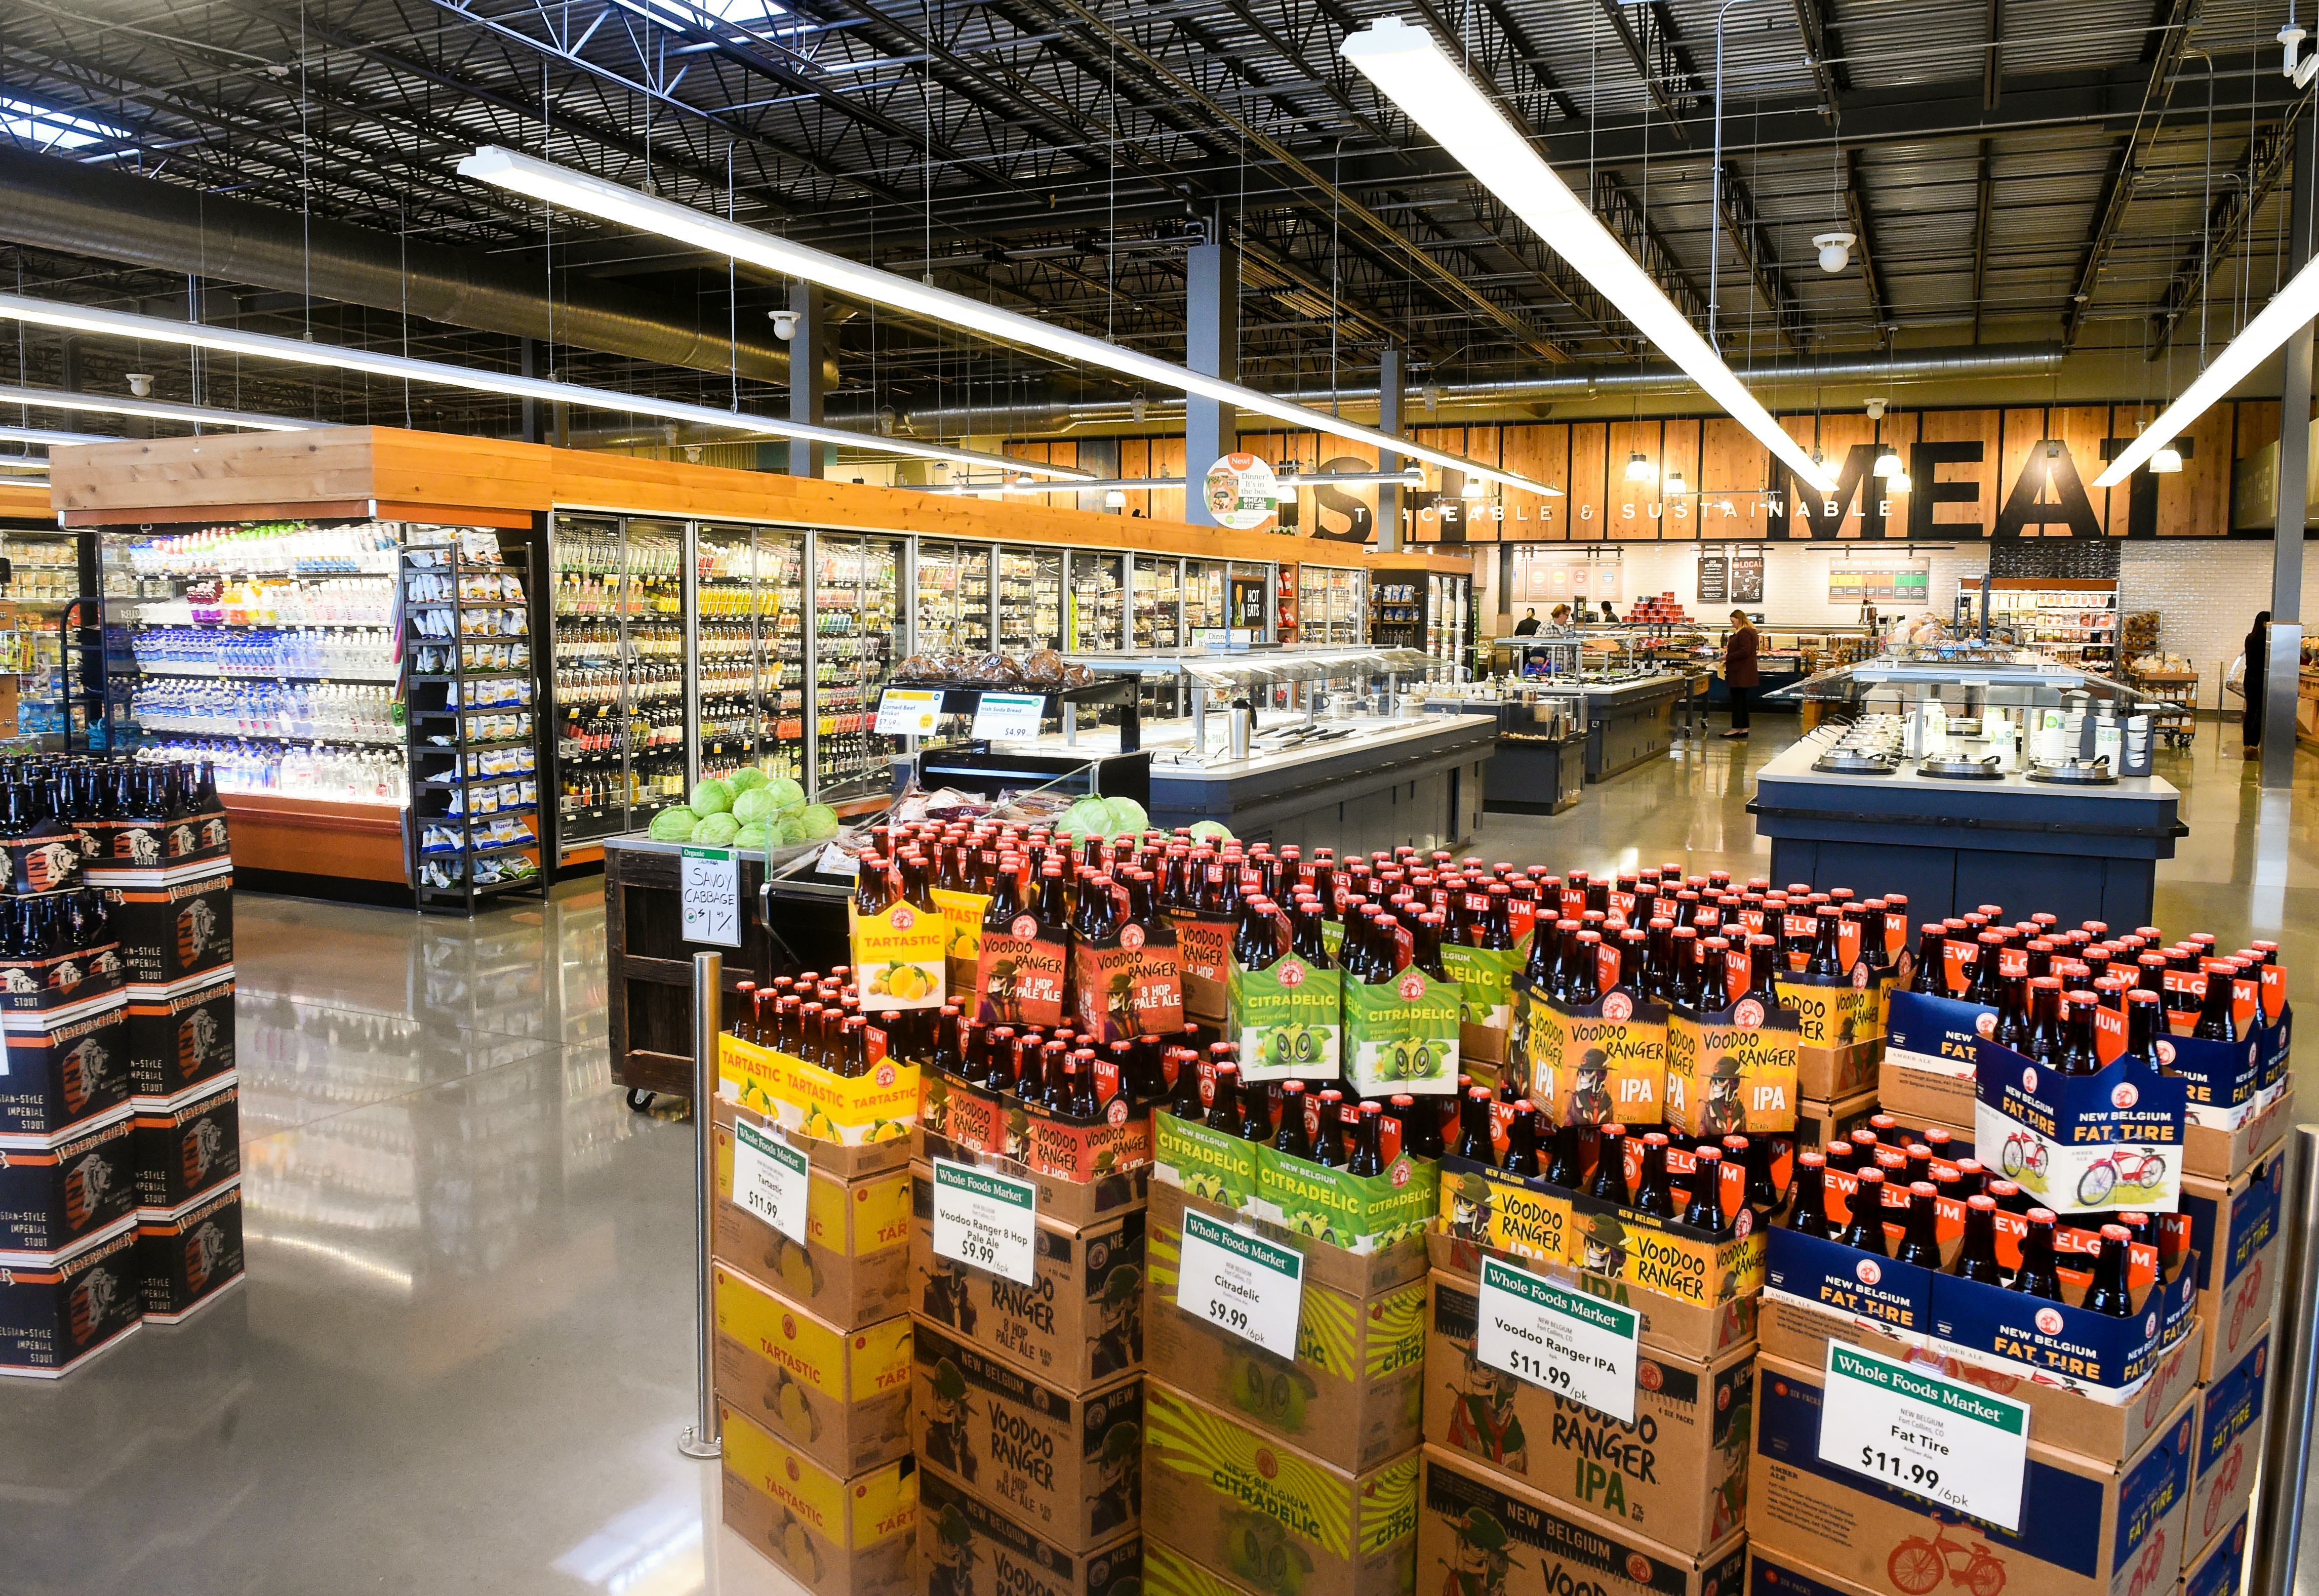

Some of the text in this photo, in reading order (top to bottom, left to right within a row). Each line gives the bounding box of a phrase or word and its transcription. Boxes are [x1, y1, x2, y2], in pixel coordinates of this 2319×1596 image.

[1776, 438, 2194, 537] MEAT
[1354, 500, 1893, 523] TACEABLE & SUSTAINABLE
[1247, 604, 1259, 617] EATS
[1248, 589, 1260, 603] HOT
[1005, 728, 1026, 736] $4.99
[684, 849, 705, 857] Organic
[168, 875, 228, 905] WEYERBACHER
[688, 867, 733, 891] SAVOY
[685, 888, 735, 906] CABBAGE
[864, 935, 940, 947] TARTASTIC
[1097, 951, 1143, 970] VOODOO
[1128, 962, 1178, 979] RANGER
[14, 997, 38, 1007] STOUT
[1134, 994, 1181, 1010] PALE ALE
[1141, 984, 1171, 997] 8 HOP
[1248, 994, 1336, 1008] CITRADELIC
[50, 1008, 123, 1049] WEYERBACHER
[1369, 1008, 1455, 1022] CITRADELIC
[1572, 1025, 1626, 1043] VOODOO
[1606, 1042, 1664, 1059] RANGER
[722, 1050, 781, 1082] TARTASTIC
[853, 1087, 917, 1109] TARTASTIC
[1620, 1078, 1653, 1103] IPA
[953, 1093, 990, 1124] VOODOO
[2080, 1111, 2172, 1122] NEW BELGIUM
[21, 1120, 45, 1129] STOUT
[954, 1114, 990, 1143] RANGER
[1177, 1126, 1229, 1149] NEW BELGIUM
[2074, 1125, 2175, 1142] FAT TIRE
[54, 1121, 129, 1166] WEYERBACHER
[739, 1127, 799, 1169] Whole Foods Market
[1159, 1132, 1249, 1176] CITRADELIC
[758, 1174, 782, 1195] Tartastic
[939, 1168, 1023, 1203] Whole Foods Market
[1261, 1168, 1360, 1214] CITRADELIC
[749, 1190, 777, 1219] $11.99
[1502, 1193, 1563, 1231] VOODOO
[1618, 1208, 1662, 1228] NEW BELGIUM
[940, 1209, 971, 1226] Voodoo
[973, 1219, 1002, 1236] Ranger
[1004, 1230, 1009, 1238] 8
[1011, 1231, 1027, 1247] Hop
[967, 1231, 999, 1249] Pale Ale
[1502, 1215, 1561, 1253] RANGER
[962, 1240, 1009, 1273] $9.99 /6pk
[1189, 1218, 1287, 1270] Whole Foods Market
[1215, 1275, 1260, 1303] Citradelic
[1489, 1267, 1617, 1328] Whole Foods Market
[1770, 1292, 1812, 1309] AMBER ALE
[1209, 1298, 1247, 1330] $9.99
[1246, 1328, 1265, 1343] /6pk
[1538, 1317, 1572, 1334] NEW BELGIUM
[1495, 1317, 1617, 1375] Voodoo Ranger IPA
[2000, 1324, 2097, 1360] NEW BELGIUM
[30, 1353, 53, 1364] STOUT
[760, 1336, 821, 1384] TARTASTIC
[1994, 1337, 2101, 1381] FAT TIRE
[962, 1352, 1024, 1395] NEW BELGIUM
[1510, 1349, 1588, 1402] $11.99 /pk
[1837, 1354, 2002, 1422] Whole Foods Market
[988, 1399, 1053, 1460] VOODOO
[1899, 1416, 1910, 1425] Fort
[1935, 1429, 1944, 1438] CO
[1901, 1408, 1944, 1428] NEW BELGIUM
[2211, 1403, 2250, 1454] FAT TIRE
[1551, 1412, 1659, 1485] RANGER
[1891, 1425, 1949, 1456] Fat Tire
[1903, 1445, 1922, 1457] Amber
[991, 1432, 1055, 1492] RANGER
[1861, 1445, 1969, 1507] $11.99 /6pk
[1575, 1457, 1626, 1517] IPA
[1212, 1469, 1322, 1540] CITRADELIC
